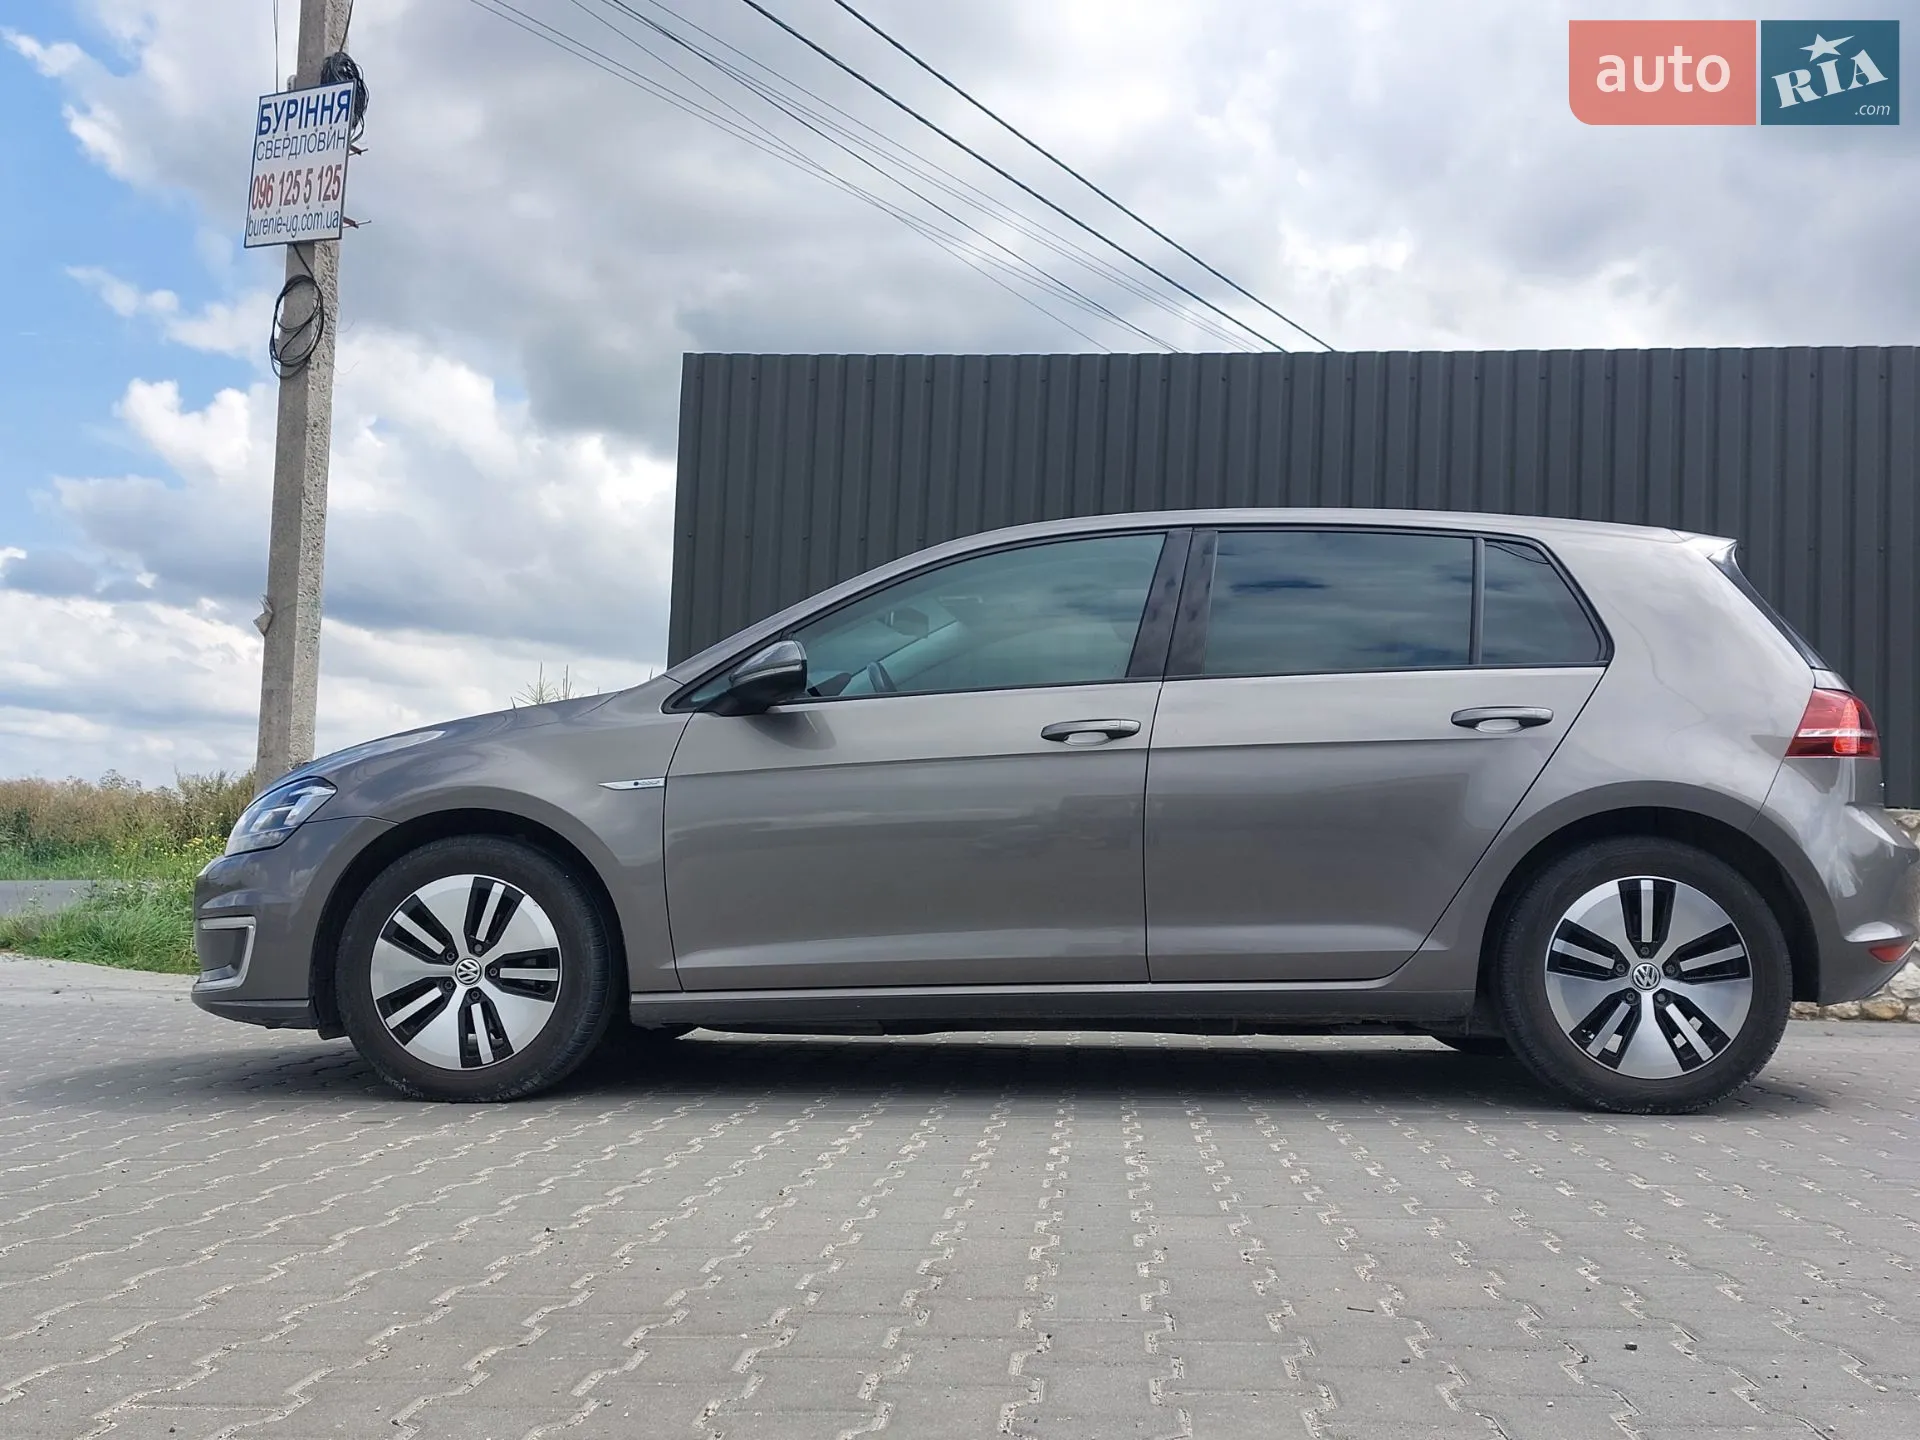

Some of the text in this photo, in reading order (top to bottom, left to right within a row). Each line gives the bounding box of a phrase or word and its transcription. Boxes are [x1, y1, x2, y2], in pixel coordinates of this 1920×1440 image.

[258, 89, 352, 136] БУРІННЯ
[256, 127, 347, 161] СВЕРДЛОВИН
[251, 163, 342, 211] 096 125 5 125
[247, 210, 340, 239] burenie-ug.com.ua
